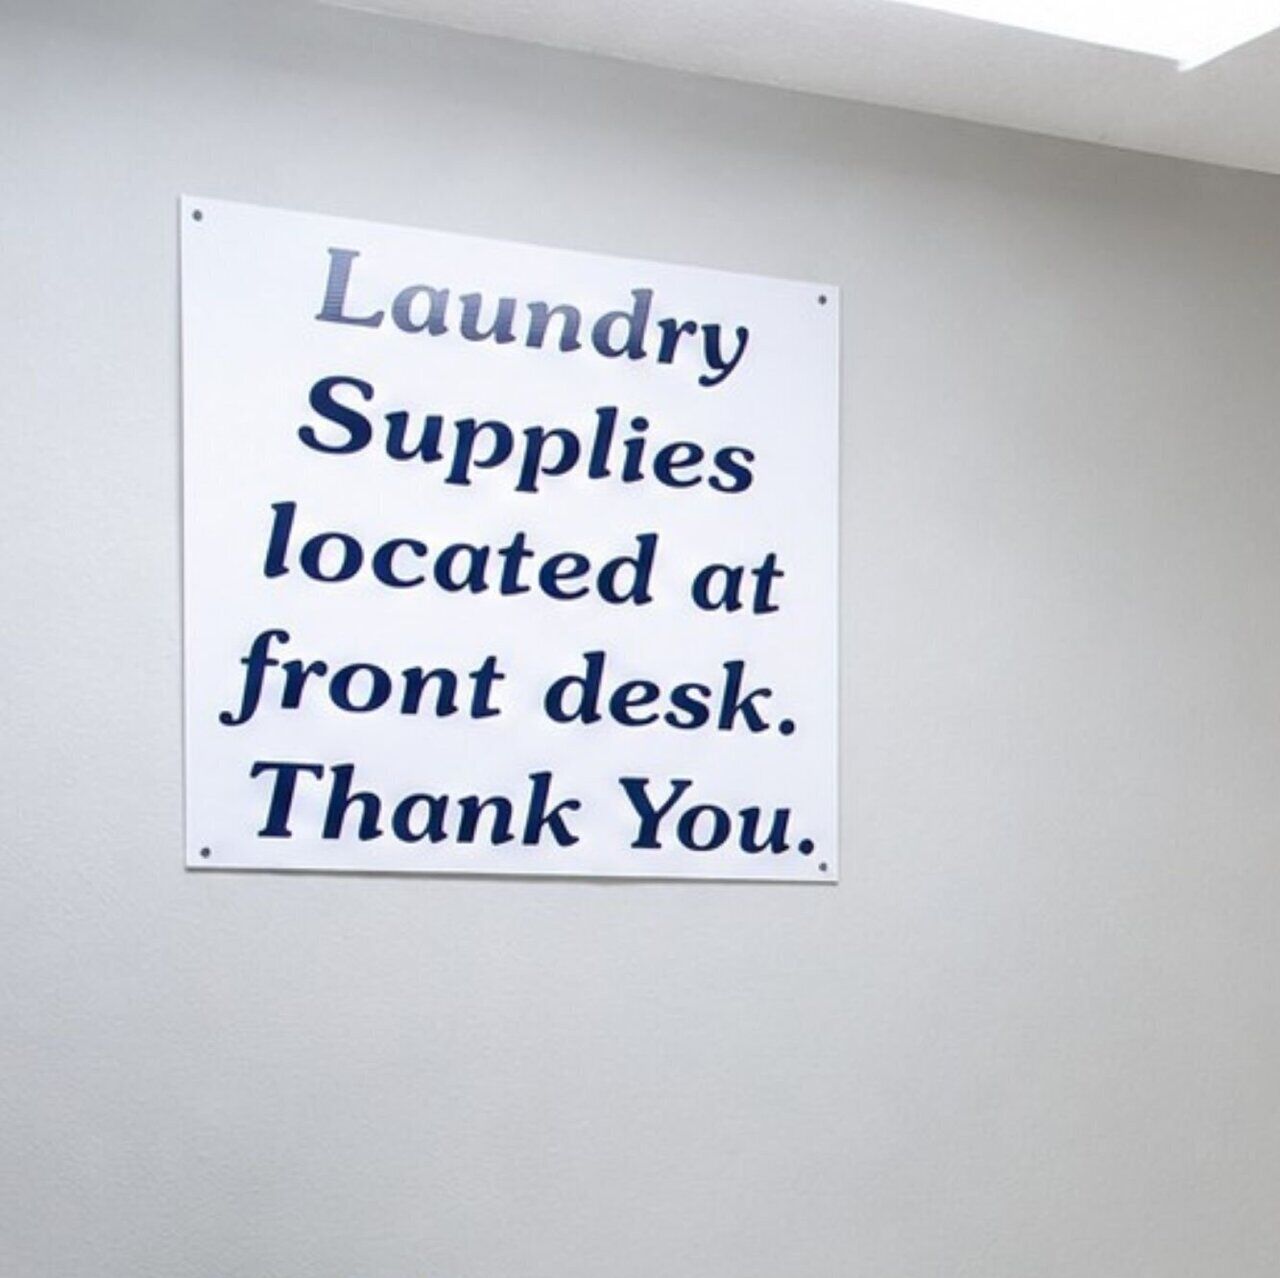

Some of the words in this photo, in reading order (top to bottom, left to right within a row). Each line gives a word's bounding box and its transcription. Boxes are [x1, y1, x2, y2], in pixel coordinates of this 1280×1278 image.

[315, 247, 749, 387] Laundry
[297, 375, 755, 495] Supplies
[263, 501, 659, 607] located
[691, 552, 785, 616] at
[218, 628, 506, 728] front
[543, 650, 796, 737] desk.
[249, 760, 582, 849] Thank
[618, 776, 815, 857] You.
